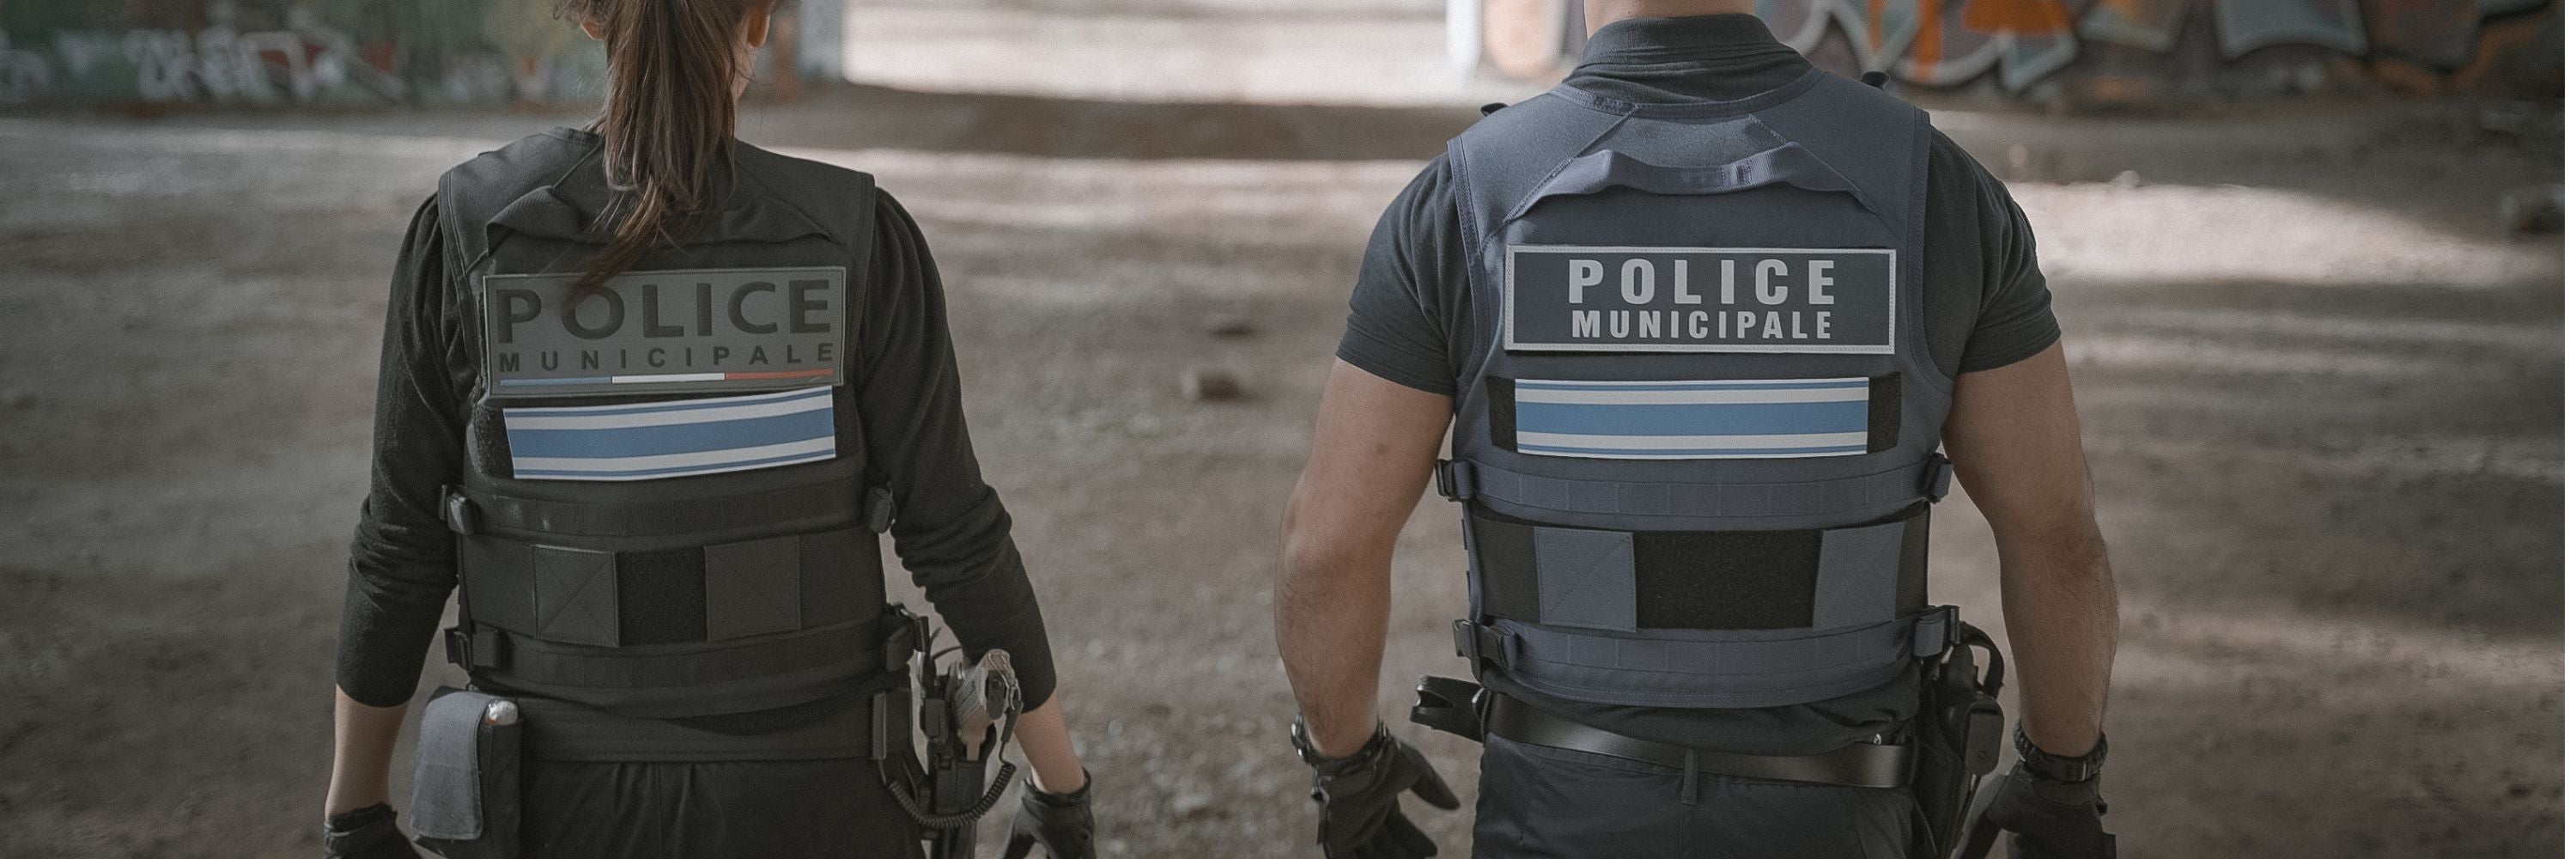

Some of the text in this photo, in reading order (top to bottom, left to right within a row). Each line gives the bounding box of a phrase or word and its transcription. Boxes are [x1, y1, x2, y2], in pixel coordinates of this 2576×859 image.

[1568, 259, 1834, 305] POLICE
[495, 279, 831, 344] POLICE
[1571, 310, 1832, 339] MUNICIPALE
[498, 343, 833, 372] MUNICIPALE
